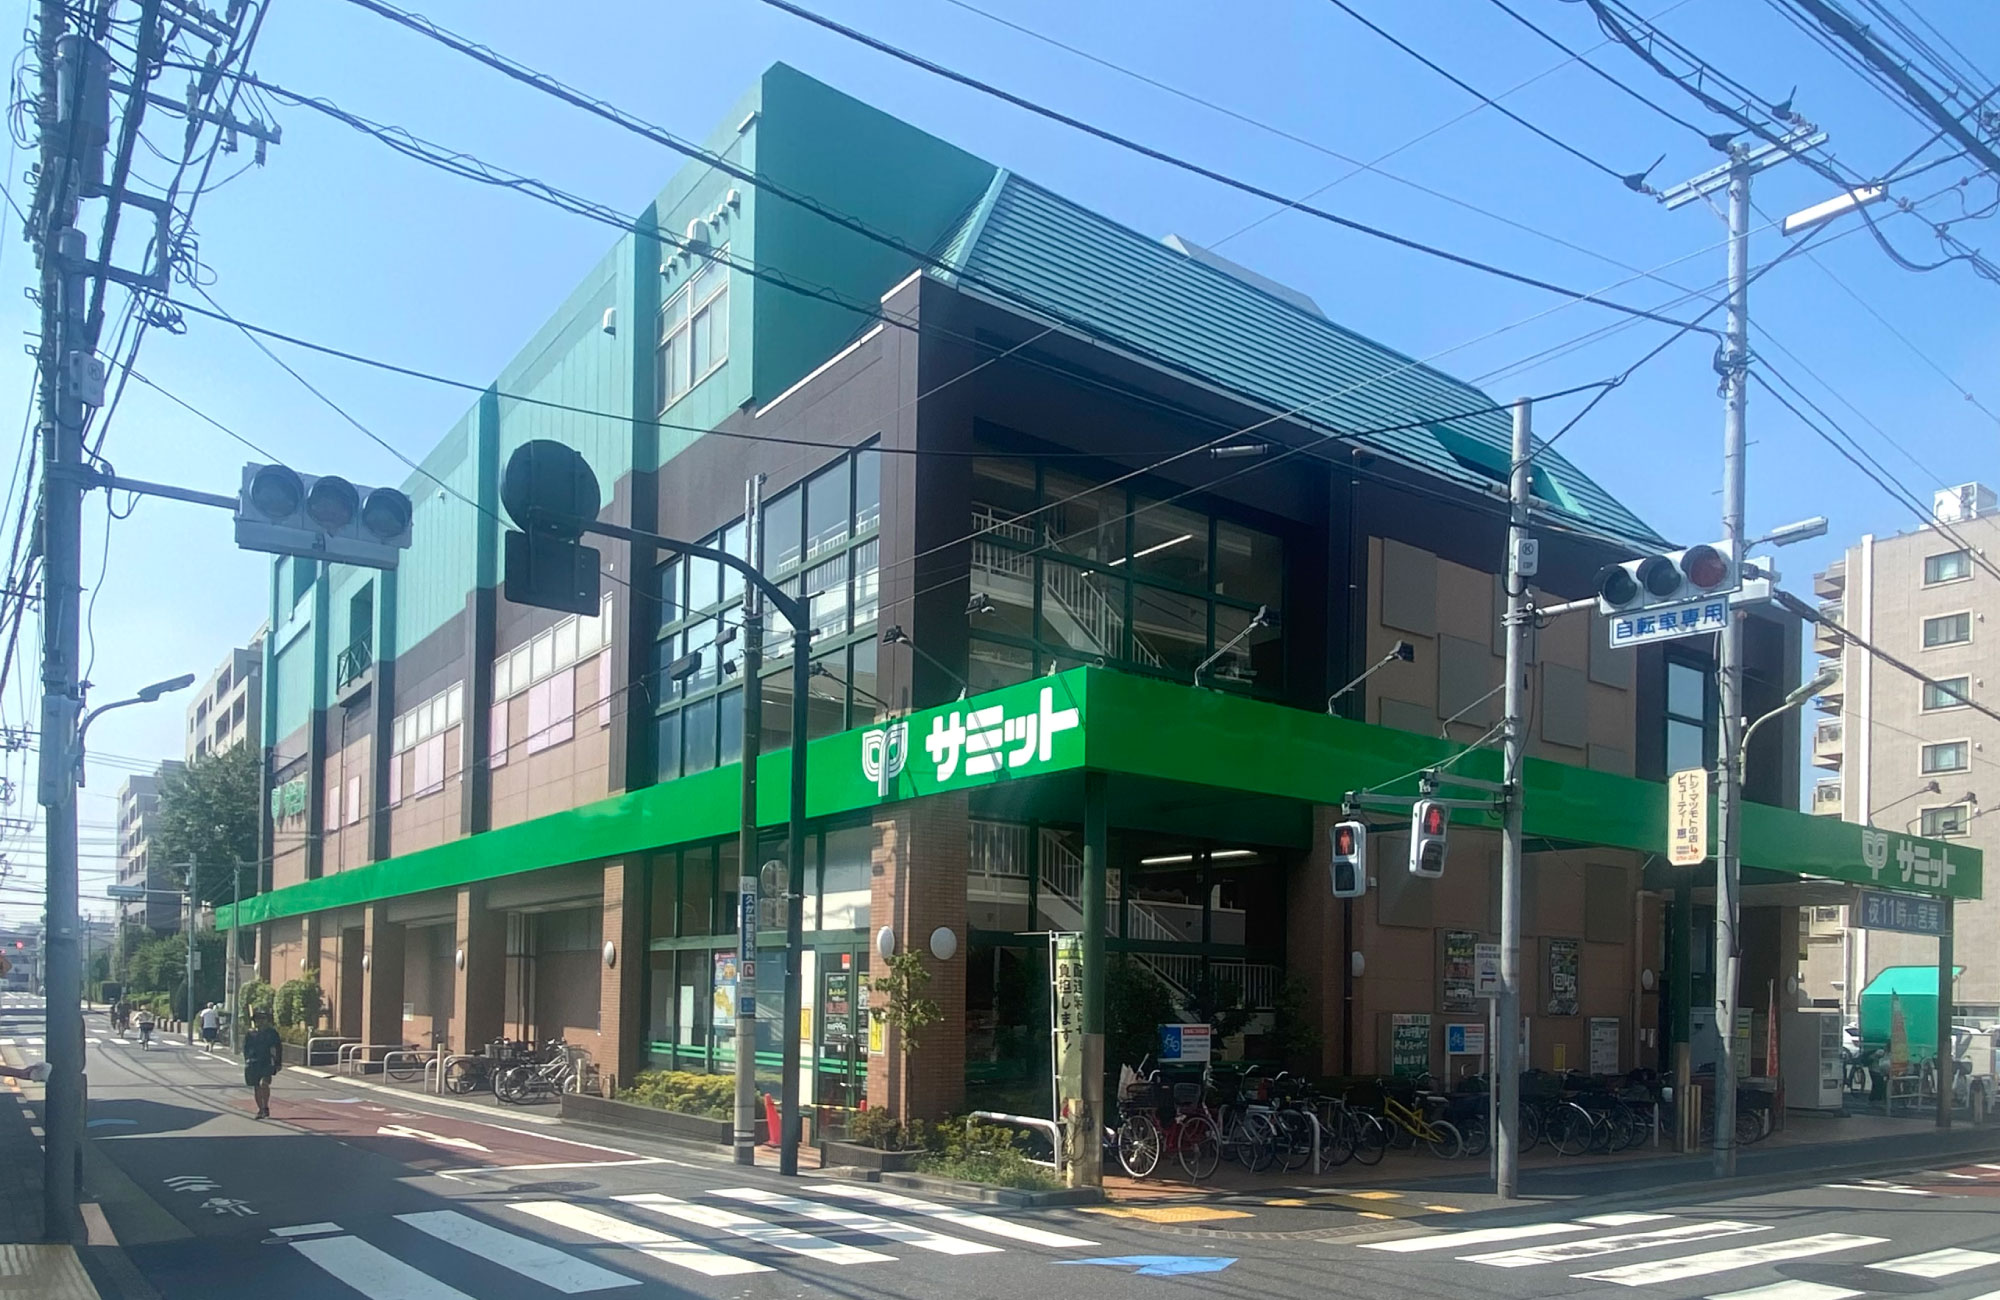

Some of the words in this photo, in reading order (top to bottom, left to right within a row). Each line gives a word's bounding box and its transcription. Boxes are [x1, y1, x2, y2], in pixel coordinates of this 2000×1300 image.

[1616, 603, 1723, 639] 自転車専用
[925, 686, 1079, 782] サミット
[1896, 839, 1956, 889] サミット
